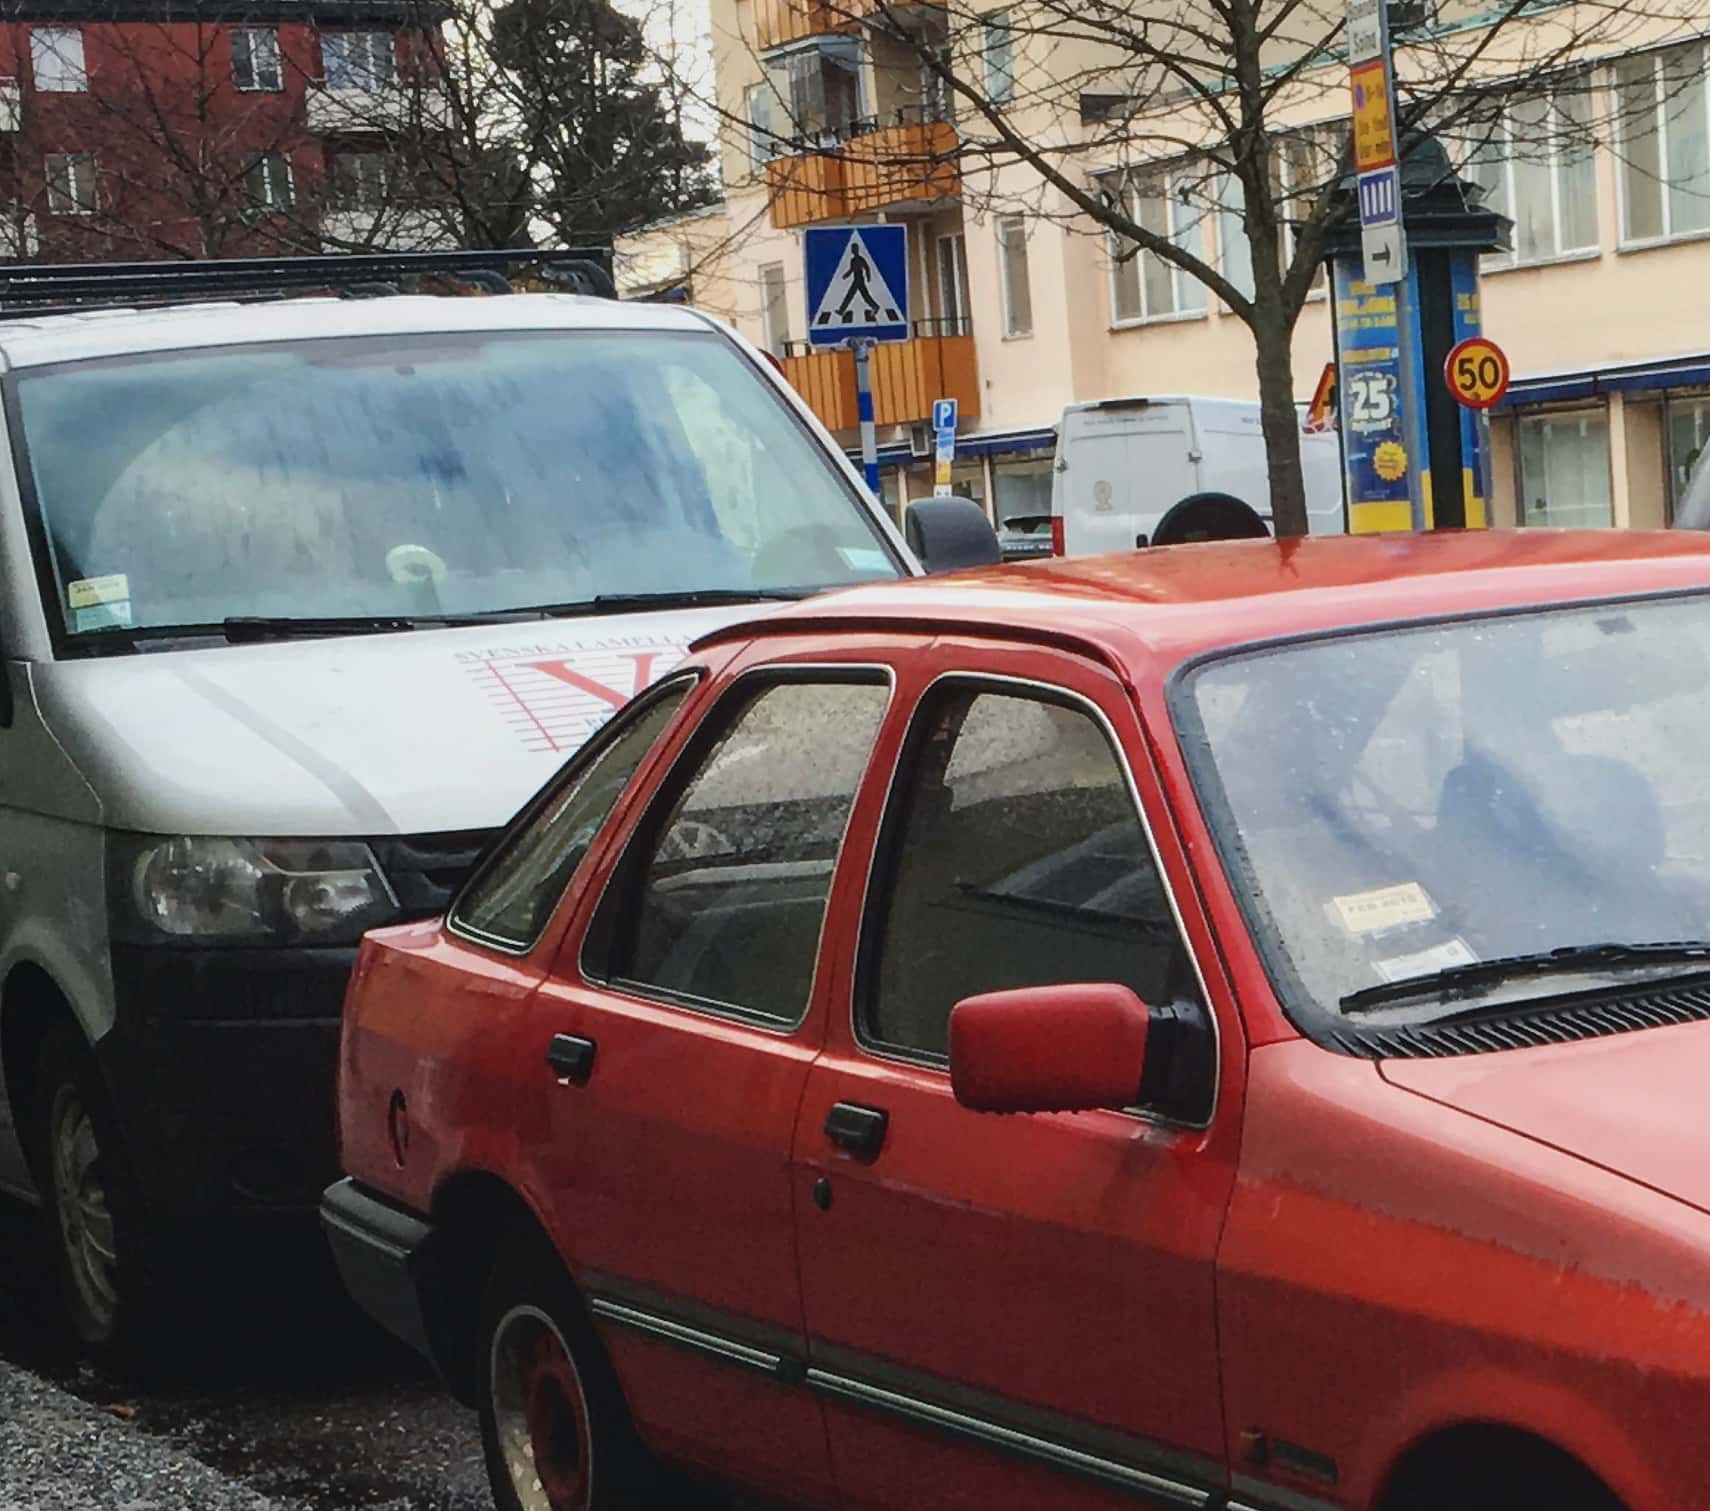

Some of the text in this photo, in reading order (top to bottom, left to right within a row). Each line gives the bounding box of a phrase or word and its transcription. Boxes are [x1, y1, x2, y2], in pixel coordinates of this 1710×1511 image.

[1458, 356, 1500, 391] 50
[940, 402, 952, 427] P
[1351, 379, 1390, 420] 25
